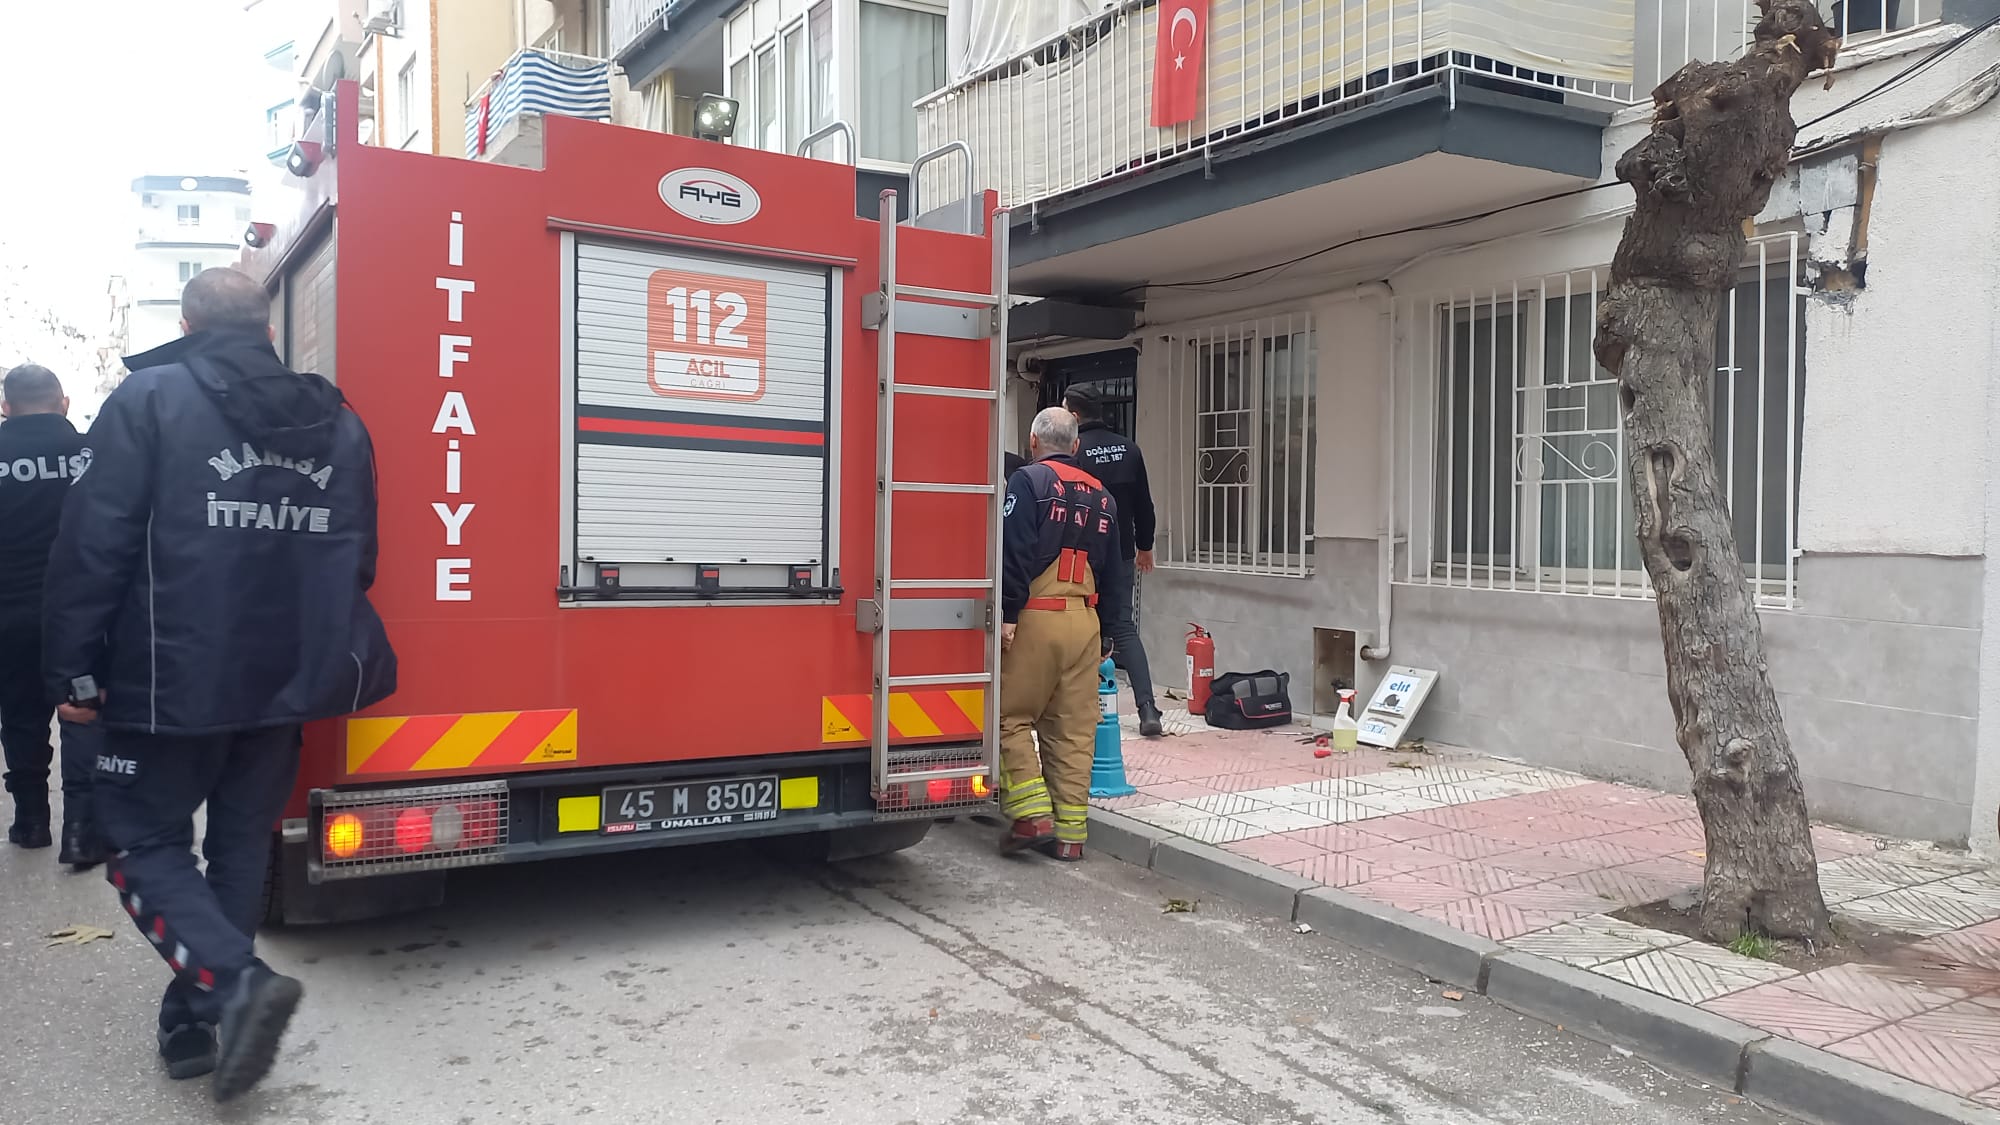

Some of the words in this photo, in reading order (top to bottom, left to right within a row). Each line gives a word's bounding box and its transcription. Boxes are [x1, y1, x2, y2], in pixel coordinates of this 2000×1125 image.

[679, 184, 741, 208] AYG
[666, 286, 749, 349] 112
[431, 211, 477, 601] İTFAİYE
[206, 491, 331, 533] İTFAİYE
[1049, 500, 1109, 534] İTAİE
[620, 790, 654, 819] 45
[672, 787, 689, 815] M
[706, 781, 774, 812] 8502
